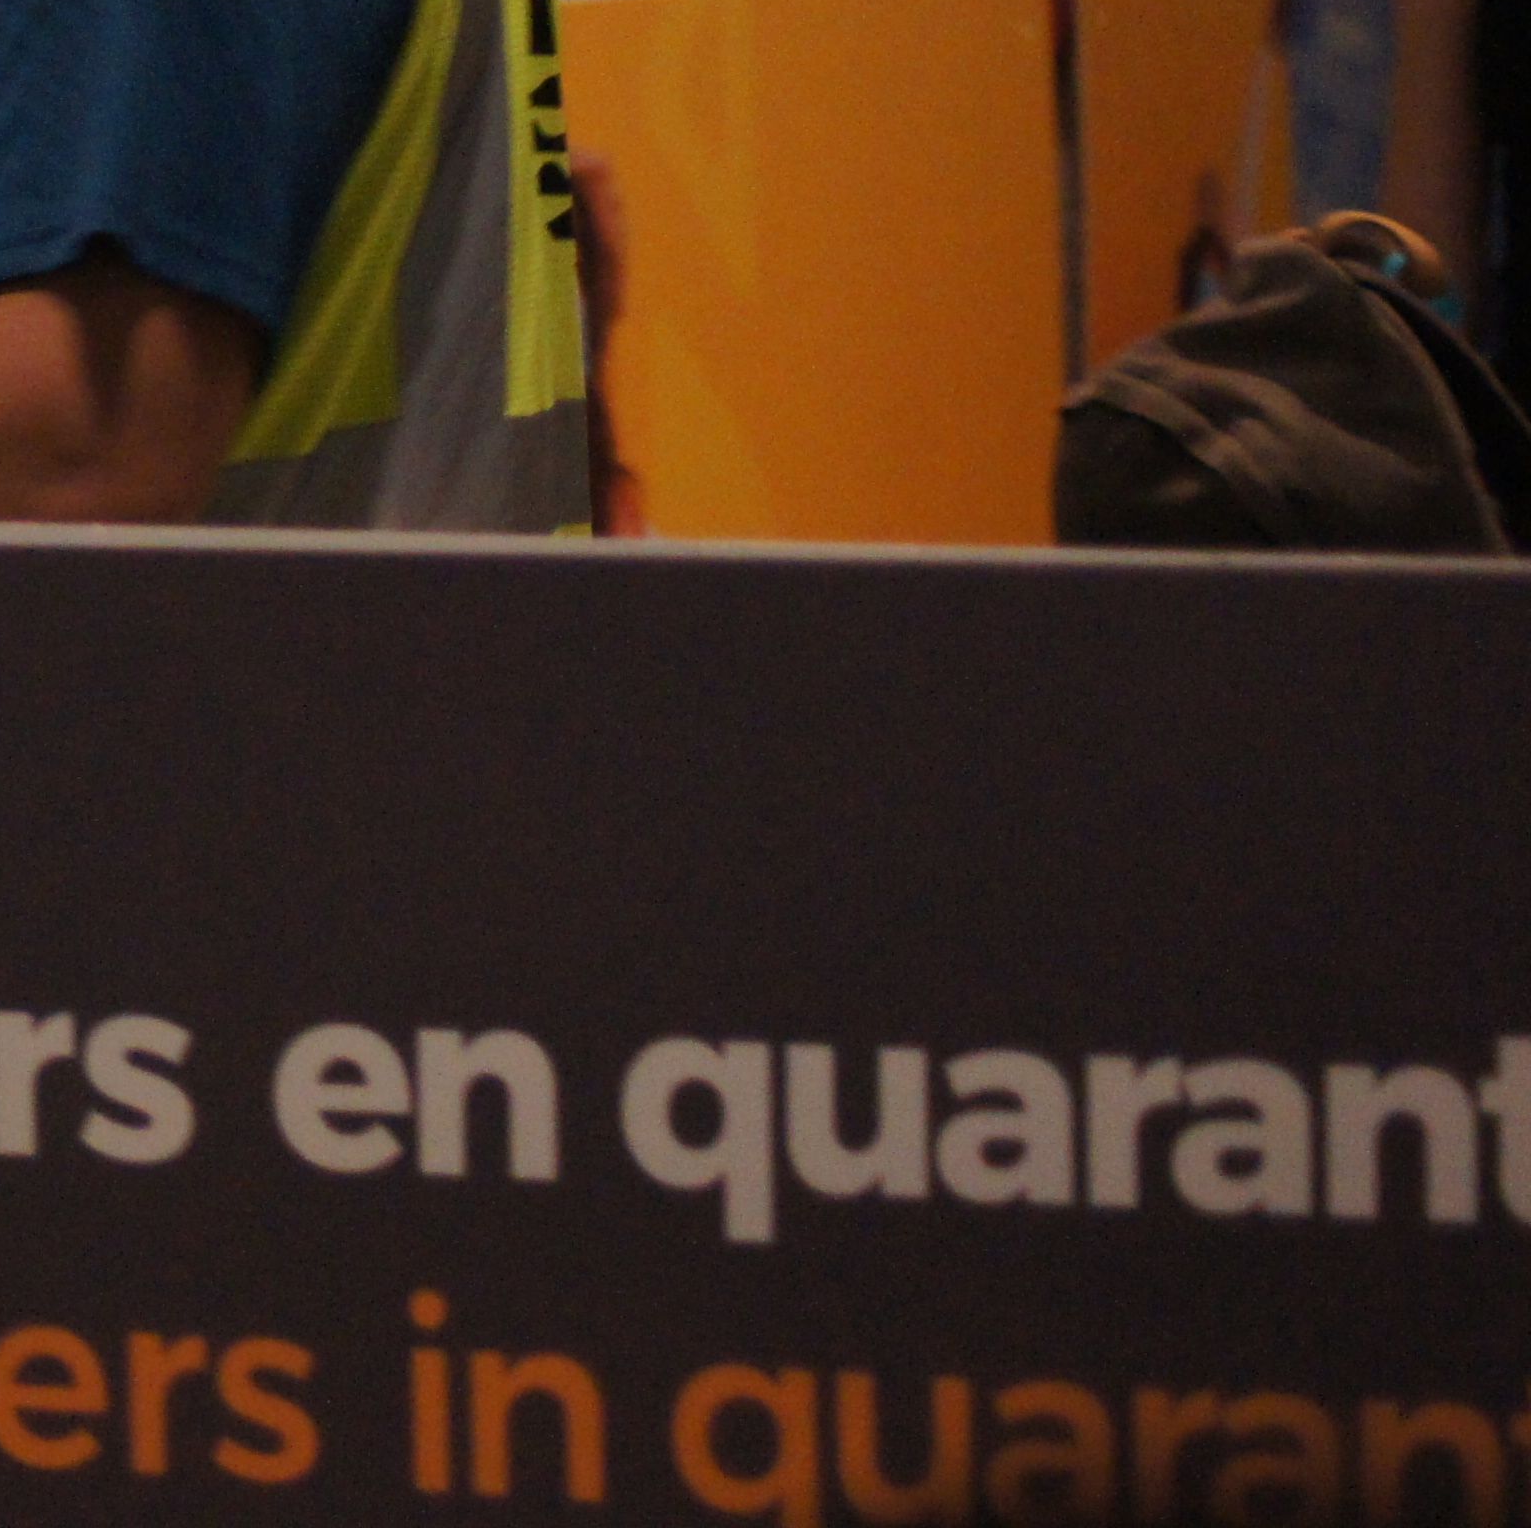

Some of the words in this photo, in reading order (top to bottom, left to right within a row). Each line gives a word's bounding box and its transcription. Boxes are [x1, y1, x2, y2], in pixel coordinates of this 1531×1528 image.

[273, 1020, 563, 1184] en
[407, 1286, 609, 1506] in
[671, 1358, 1531, 1528] quaran
